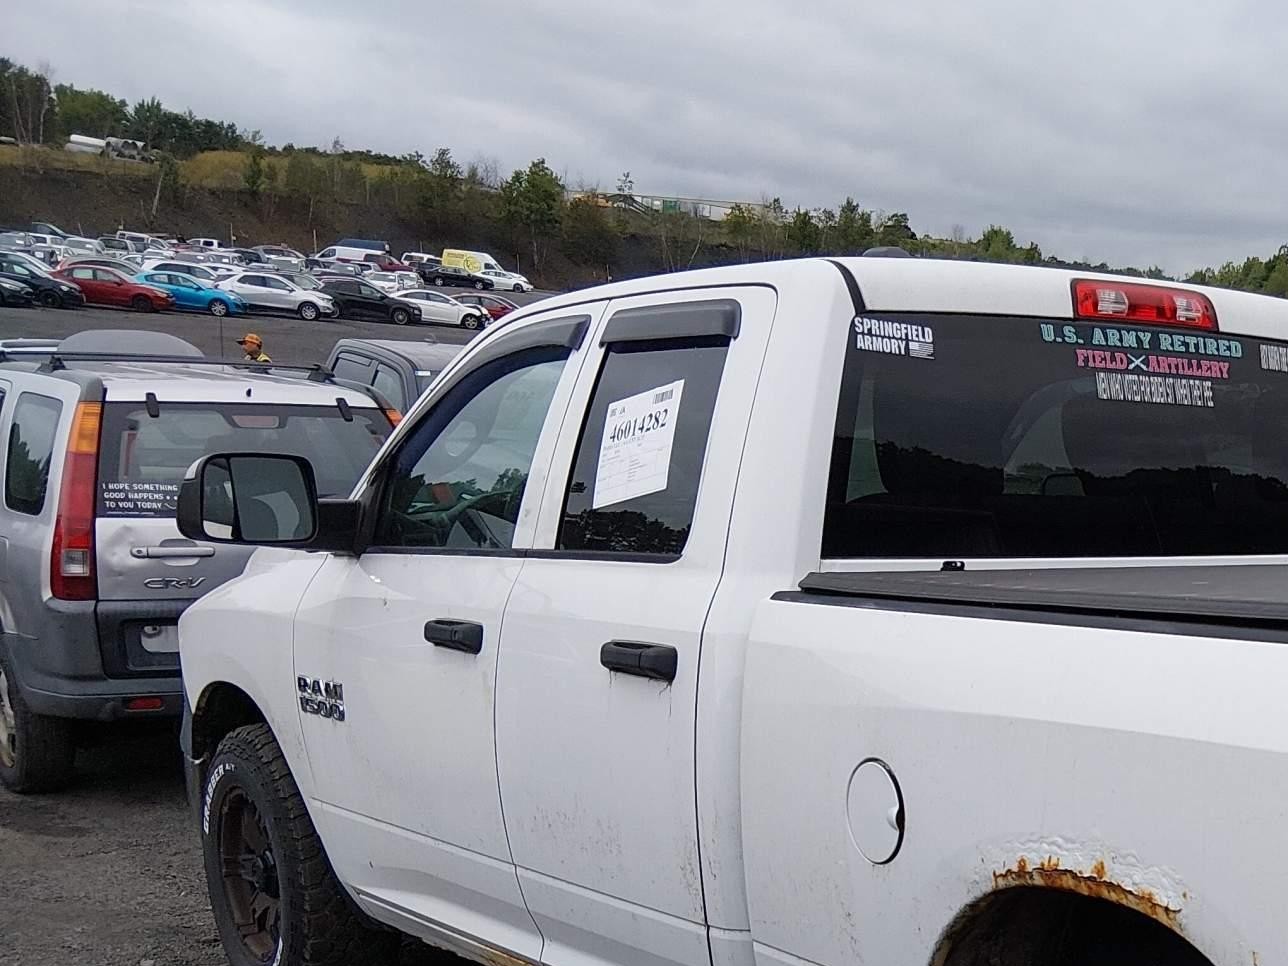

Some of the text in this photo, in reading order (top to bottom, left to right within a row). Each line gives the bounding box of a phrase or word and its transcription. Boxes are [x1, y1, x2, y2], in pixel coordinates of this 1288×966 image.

[854, 316, 933, 343] SPRINGFIELD
[1040, 323, 1243, 358] U.S. ARMY RETIRED
[856, 334, 906, 356] ARMORY
[1076, 348, 1230, 379] FIELD ARTILLERY
[610, 408, 668, 442] 46014282
[128, 492, 164, 500] HAPPENS
[132, 483, 178, 491] SOMETHING
[118, 501, 134, 509] YOU
[144, 577, 206, 589] CR-V
[298, 676, 343, 701] RAM
[299, 696, 345, 721] 1500
[204, 764, 224, 835] GRABBER
